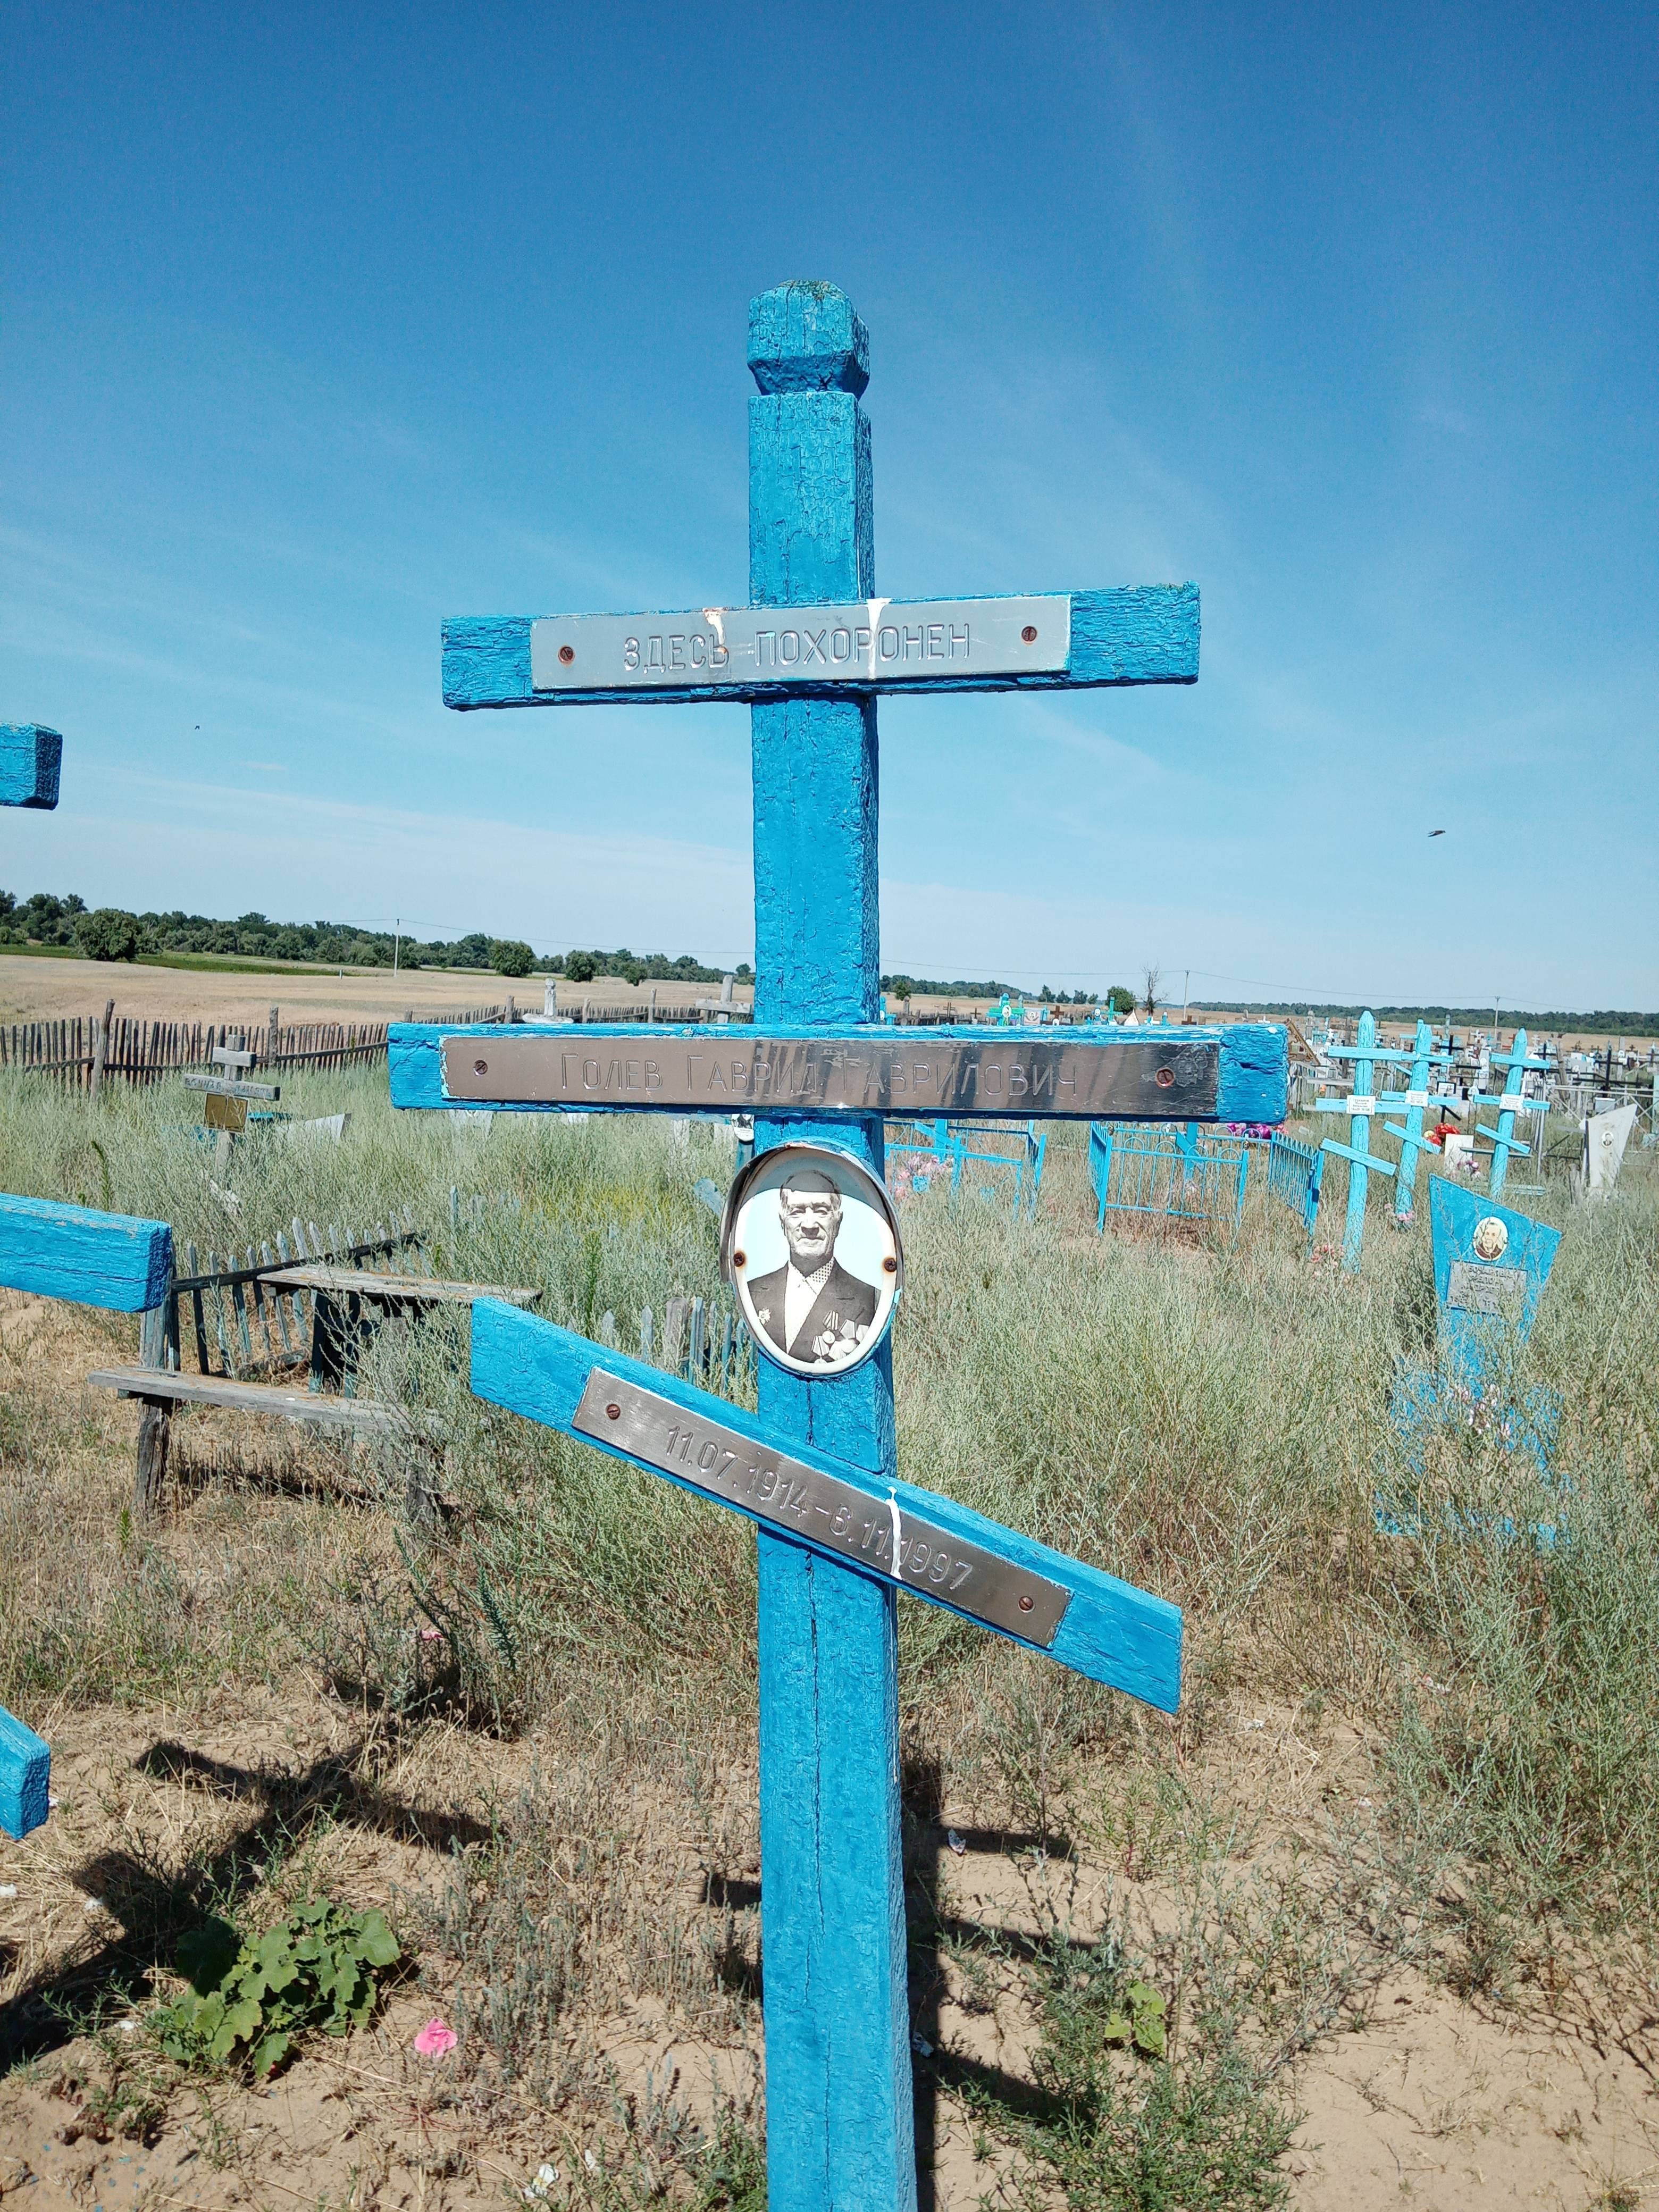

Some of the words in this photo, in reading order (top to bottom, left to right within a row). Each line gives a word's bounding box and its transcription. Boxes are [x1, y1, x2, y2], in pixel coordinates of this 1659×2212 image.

[624, 634, 729, 674] ЗДЕСЬ
[755, 623, 969, 667] ПОХОРОНЕН
[562, 1053, 663, 1091] ГОЛЕВ
[843, 1056, 1077, 1096] ГАВРИЛОВИЧ
